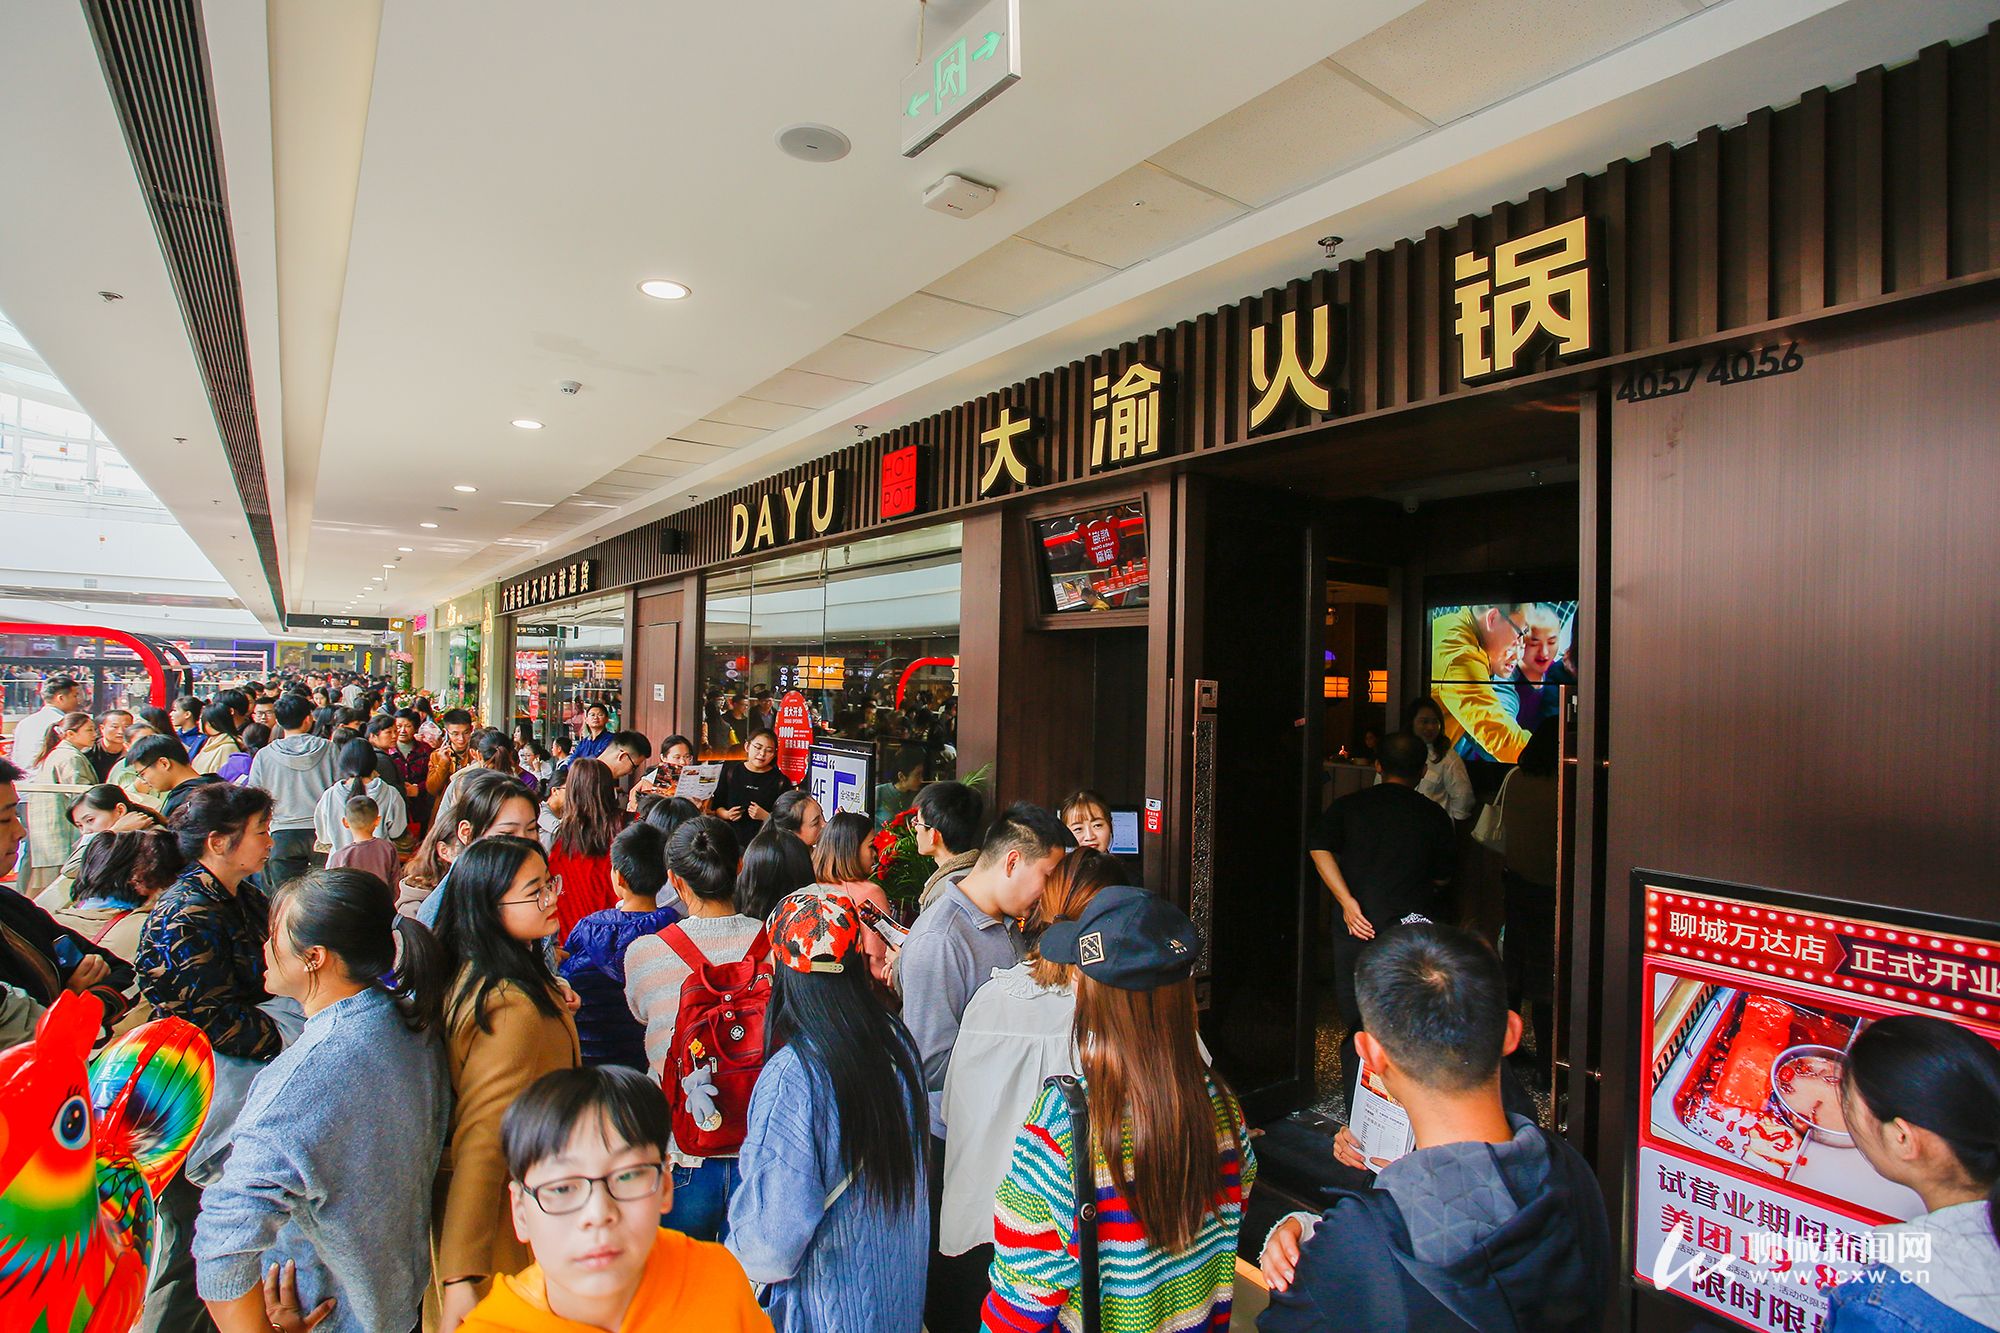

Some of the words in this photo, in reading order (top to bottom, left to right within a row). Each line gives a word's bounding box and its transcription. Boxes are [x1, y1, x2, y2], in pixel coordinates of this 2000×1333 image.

[979, 215, 1592, 495] 大渝火锅
[1616, 361, 1702, 403] 4057
[1707, 341, 1803, 385] 4056
[884, 453, 914, 478] HOT
[731, 469, 836, 555] DAYU
[884, 485, 913, 511] POT
[1669, 911, 1827, 964] 聊城万达店
[1850, 943, 2000, 998] 正式开业
